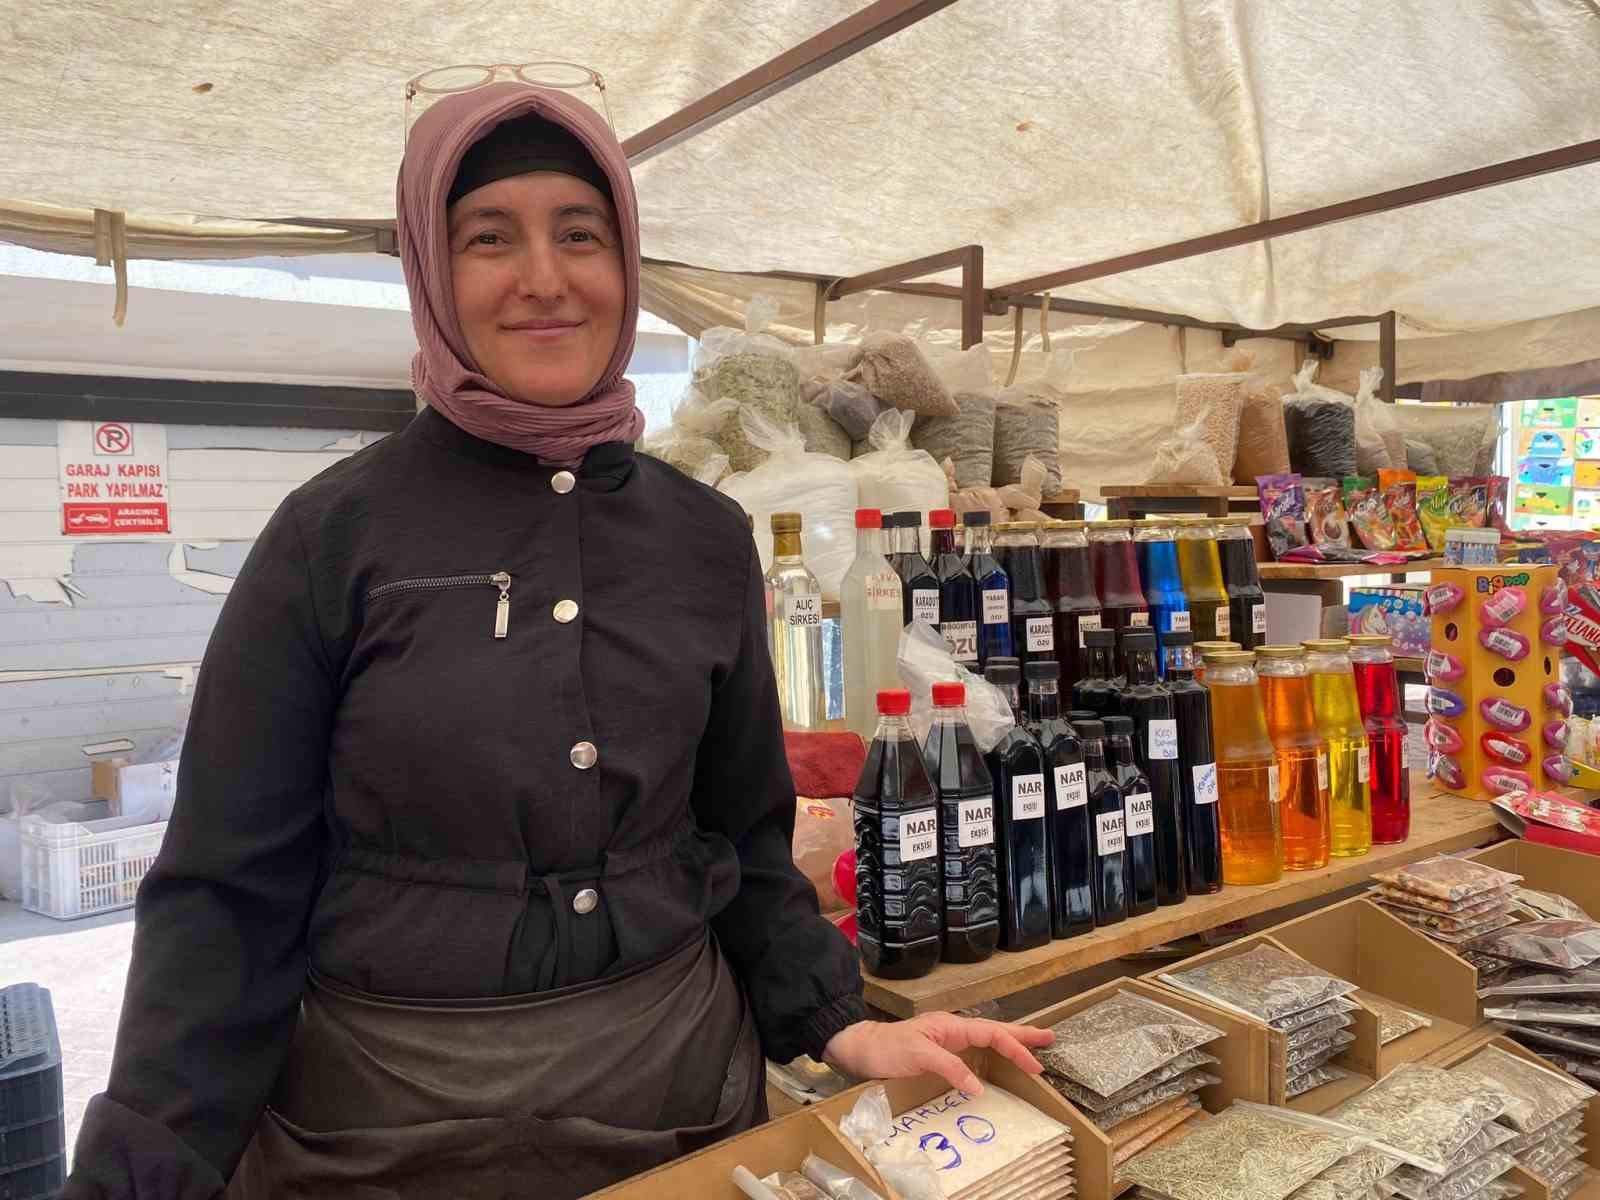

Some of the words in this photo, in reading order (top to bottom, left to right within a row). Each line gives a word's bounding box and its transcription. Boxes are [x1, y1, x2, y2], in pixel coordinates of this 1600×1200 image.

[66, 464, 110, 477] GARAJ
[118, 464, 160, 477] KAPISI
[67, 483, 98, 497] PARK
[106, 483, 163, 497] YAPILMAZ
[795, 599, 814, 610] ALIÇ
[790, 612, 820, 625] SİRKESİ
[1060, 770, 1084, 785] NAR
[1017, 781, 1042, 795] NAR
[964, 806, 993, 822] NAR
[1130, 800, 1152, 814] NAR
[906, 818, 937, 835] NAR
[1102, 817, 1124, 833] NAR
[918, 1114, 996, 1172] 30
